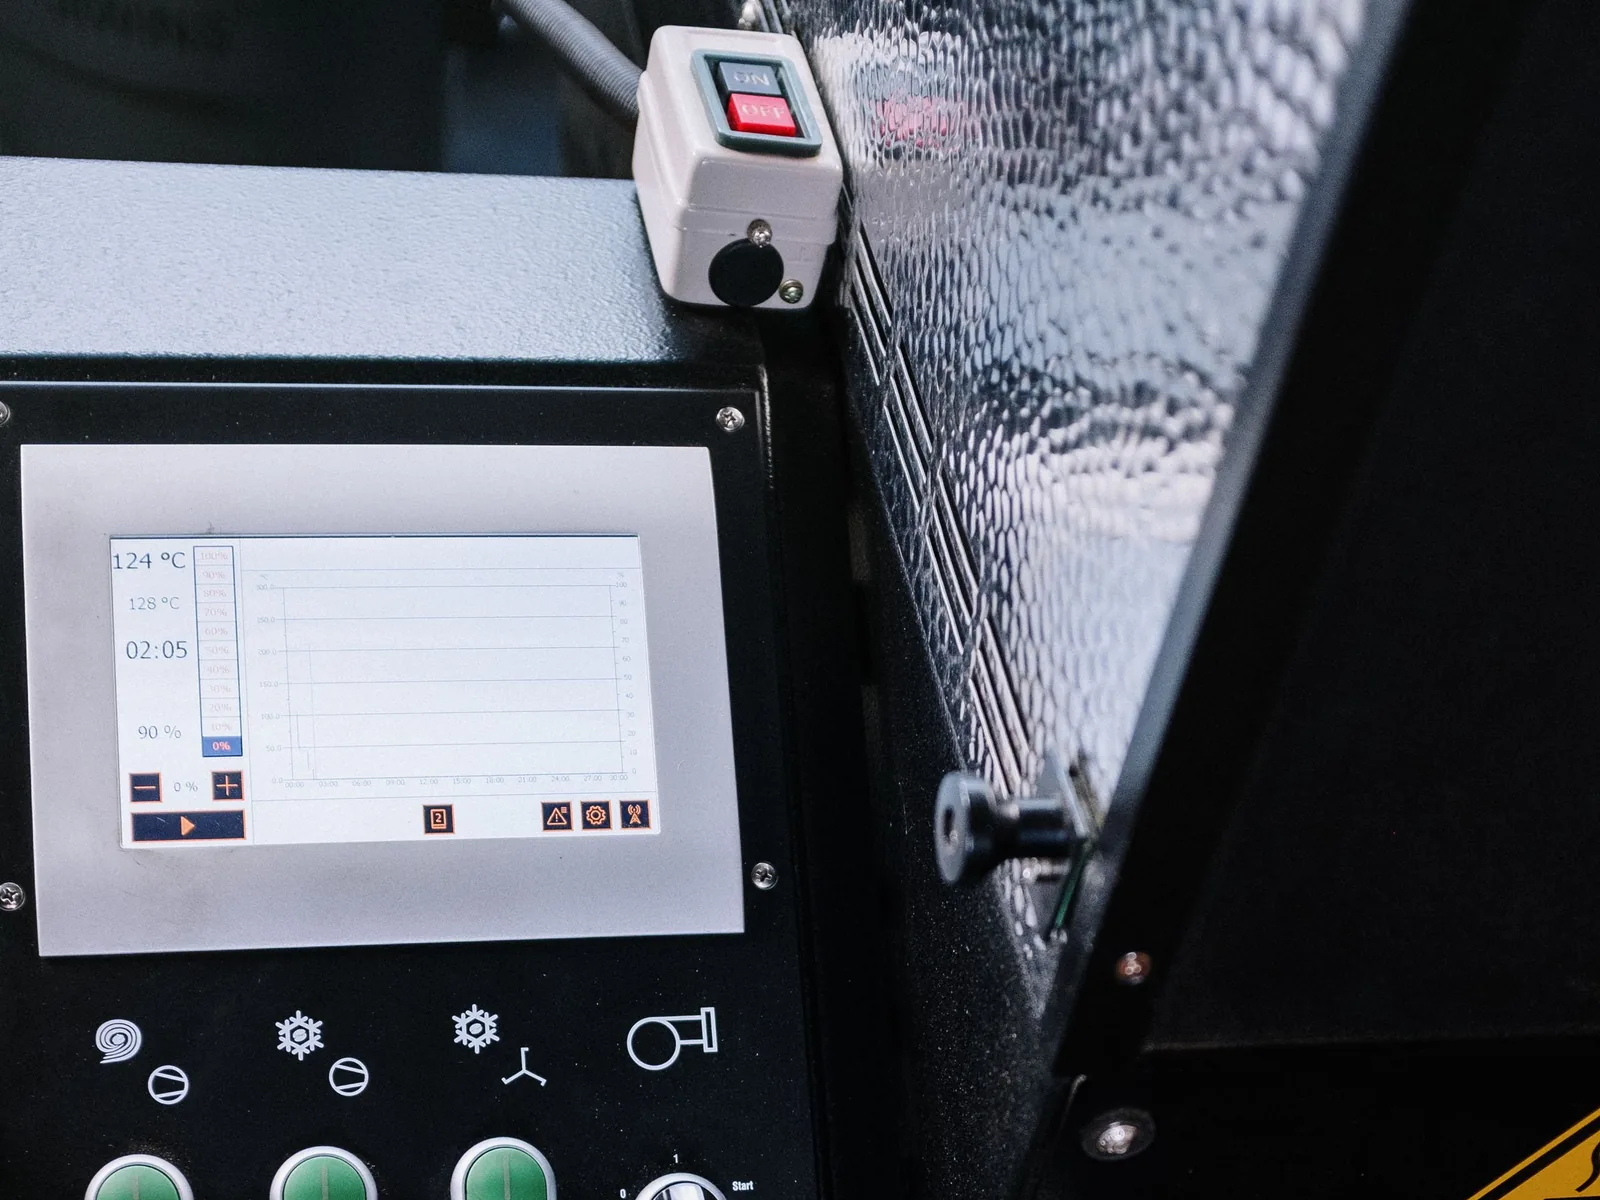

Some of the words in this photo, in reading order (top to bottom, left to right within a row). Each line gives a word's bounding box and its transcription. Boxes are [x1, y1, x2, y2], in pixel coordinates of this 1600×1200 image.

[733, 71, 770, 86] ON
[741, 103, 785, 119] OFF
[113, 552, 152, 569] 124
[129, 597, 156, 610] 128
[126, 640, 188, 659] 02:05
[138, 725, 158, 739] 90
[163, 724, 182, 739] %
[212, 741, 231, 751] 0%
[173, 781, 181, 792] 0
[186, 781, 198, 792] %
[435, 812, 442, 823] 2
[673, 1153, 679, 1164] 1
[732, 1180, 754, 1191] Start
[619, 1188, 627, 1199] 0
